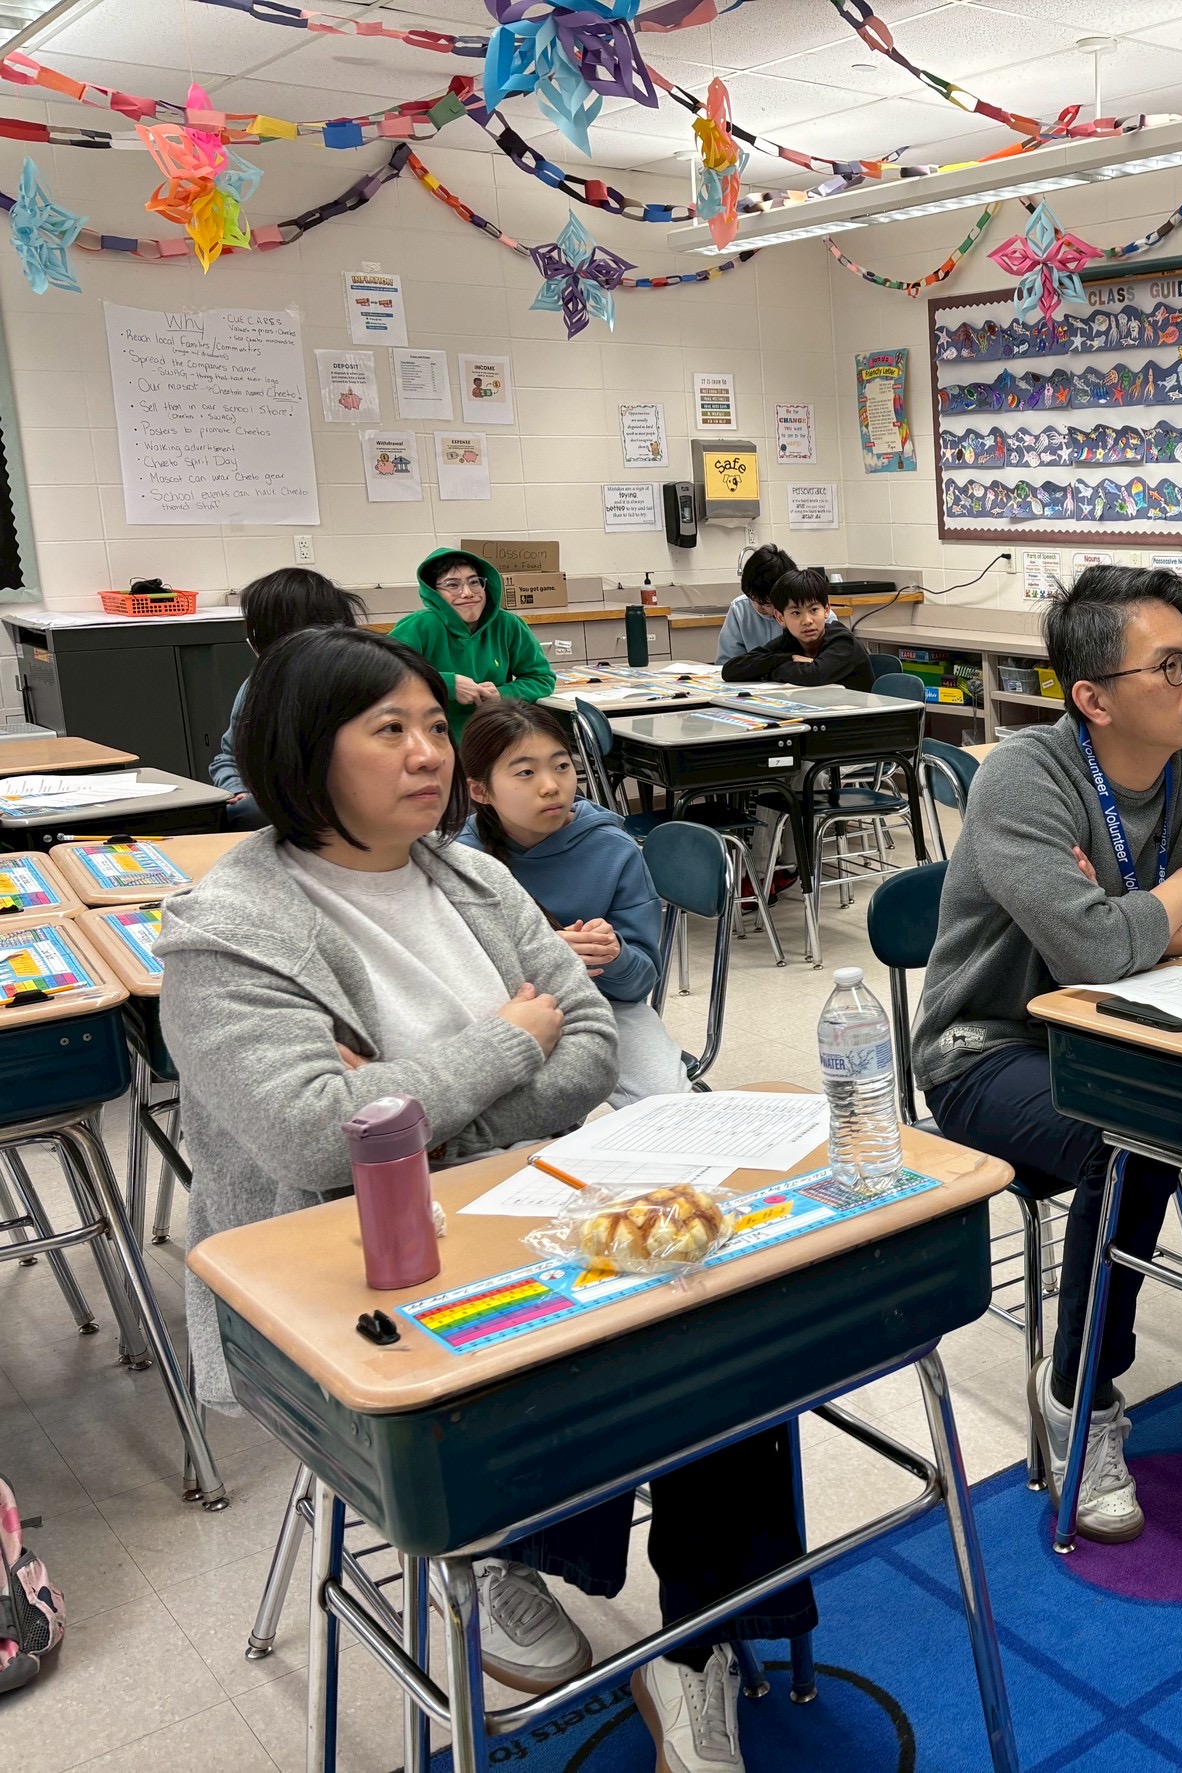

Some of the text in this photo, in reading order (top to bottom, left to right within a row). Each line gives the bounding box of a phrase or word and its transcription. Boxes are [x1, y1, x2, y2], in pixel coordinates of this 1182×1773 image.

[1088, 285, 1135, 307] CLASS
[164, 312, 205, 339] Why
[126, 329, 175, 345] Reach local
[129, 350, 166, 368] Spread
[172, 356, 184, 367] the
[232, 366, 256, 374] name
[138, 378, 160, 392] Our
[215, 456, 238, 471] Day
[714, 457, 747, 474] Safe
[482, 542, 547, 559] Classroom
[1084, 555, 1100, 563] Nouns
[1082, 739, 1109, 797] Volunteer
[1104, 805, 1128, 863] Volunteer
